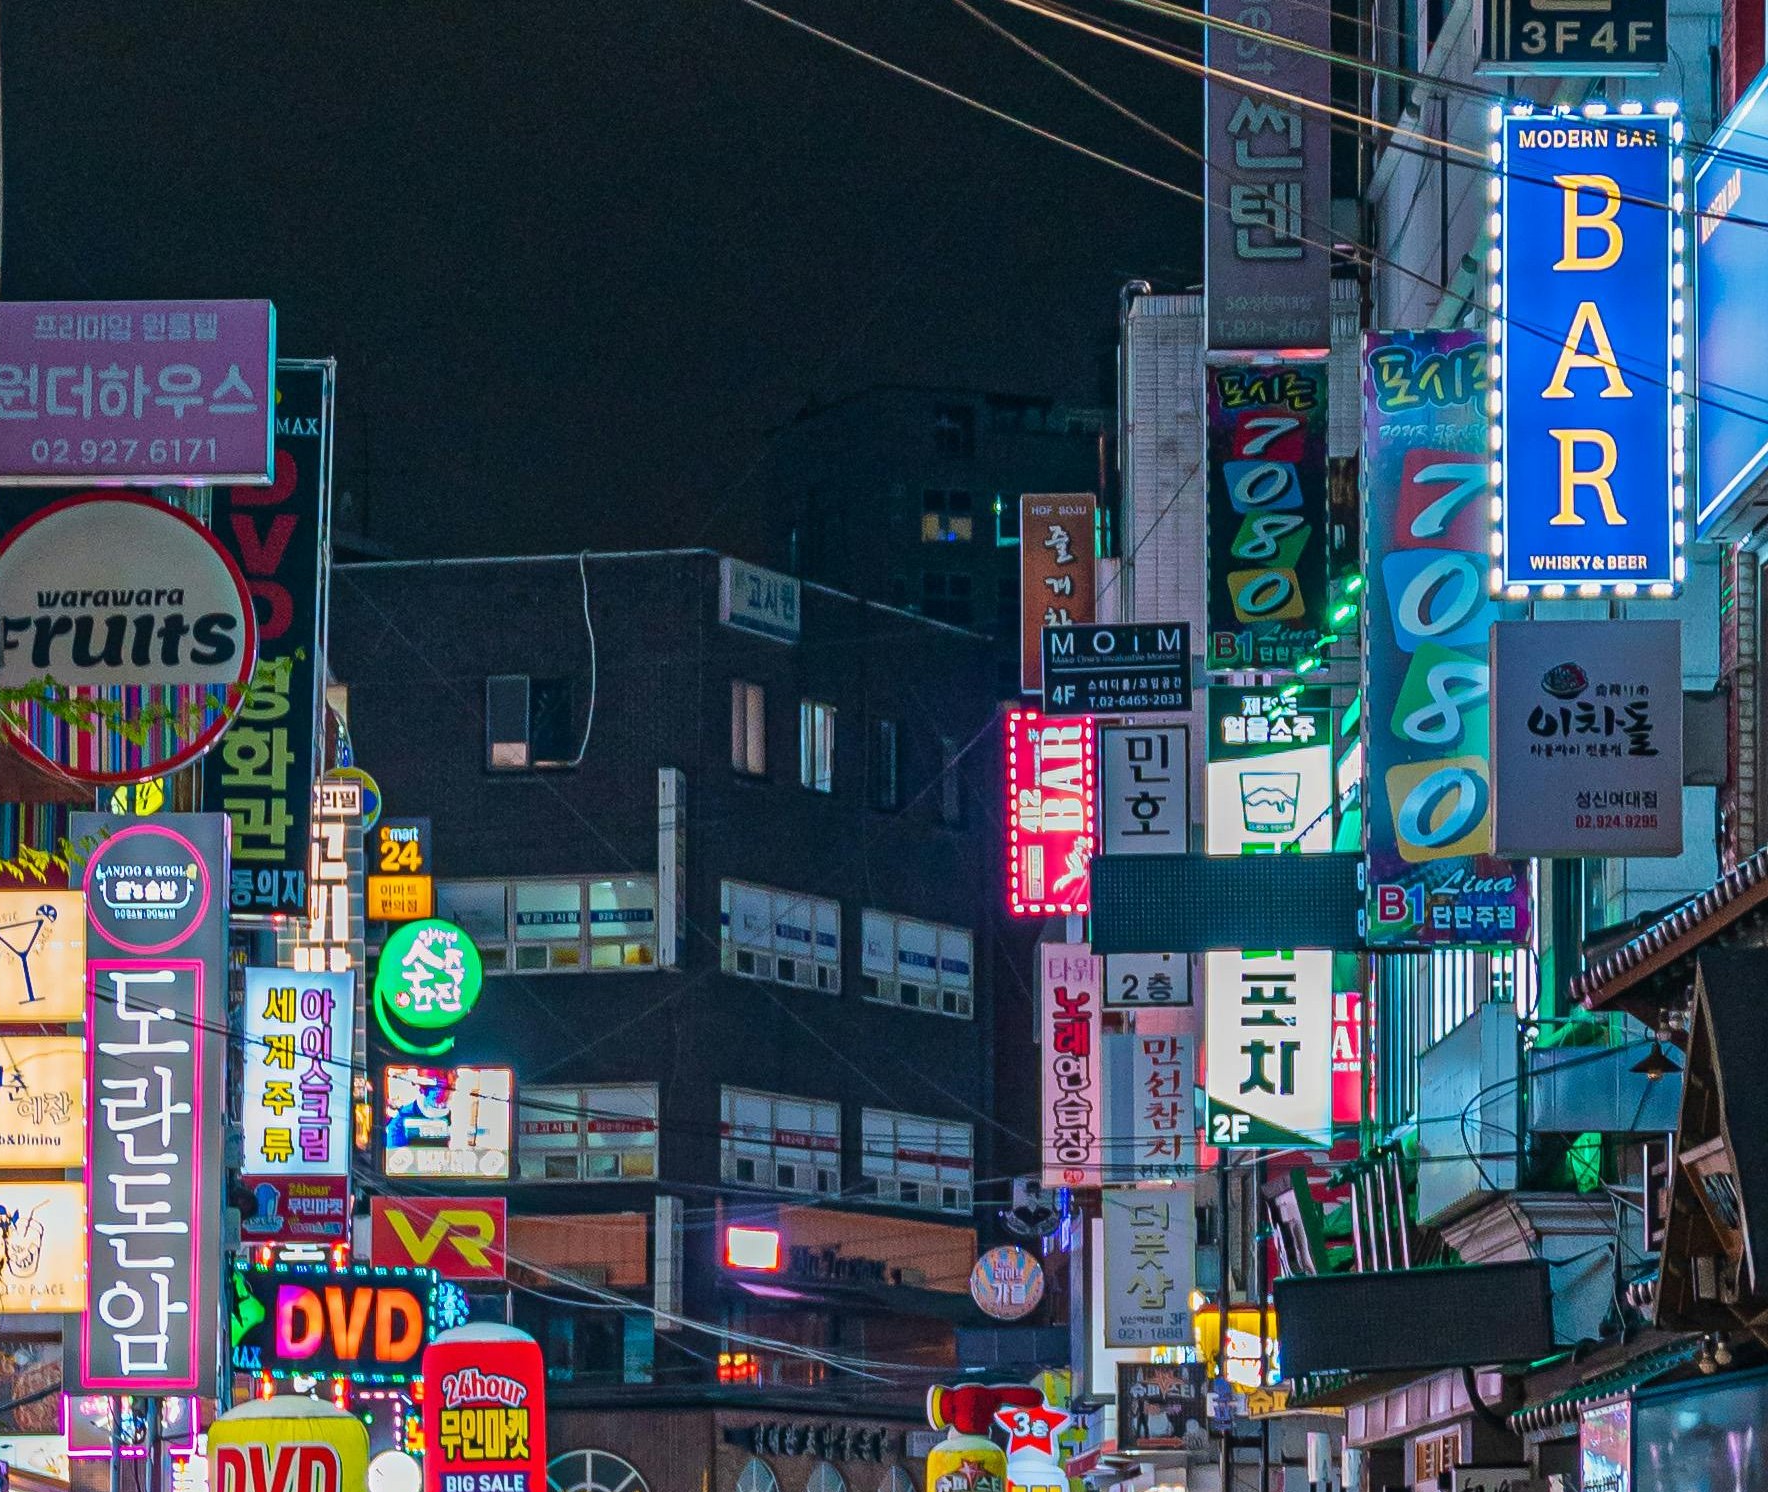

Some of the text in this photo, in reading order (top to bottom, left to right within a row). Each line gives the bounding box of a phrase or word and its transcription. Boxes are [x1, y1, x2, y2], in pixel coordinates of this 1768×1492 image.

[1519, 130, 1658, 149] MODERN BAR
[33, 311, 133, 344] 프리미엄
[1541, 174, 1634, 527] BAR
[31, 438, 219, 466] 02.927.6171
[35, 587, 185, 609] warawara
[1213, 631, 1253, 662] B1
[1052, 684, 1077, 706] 4F
[1040, 724, 1084, 834] BAR
[1575, 789, 1658, 810] 성신여대점
[380, 840, 423, 872] 24
[1434, 870, 1517, 897] Lina
[1378, 884, 1424, 925] B1
[1432, 905, 1516, 930] 단란주점
[261, 985, 297, 1165] 세계주류
[297, 987, 336, 1164] 아이스크림
[1053, 985, 1097, 1165] 노래연습장
[1212, 1113, 1251, 1144] 2F
[94, 968, 191, 1377] 도란돈암
[383, 1209, 497, 1267] VR
[276, 1284, 425, 1363] DVD
[442, 1367, 528, 1409] 24hour
[440, 1408, 530, 1461] 무인마켓
